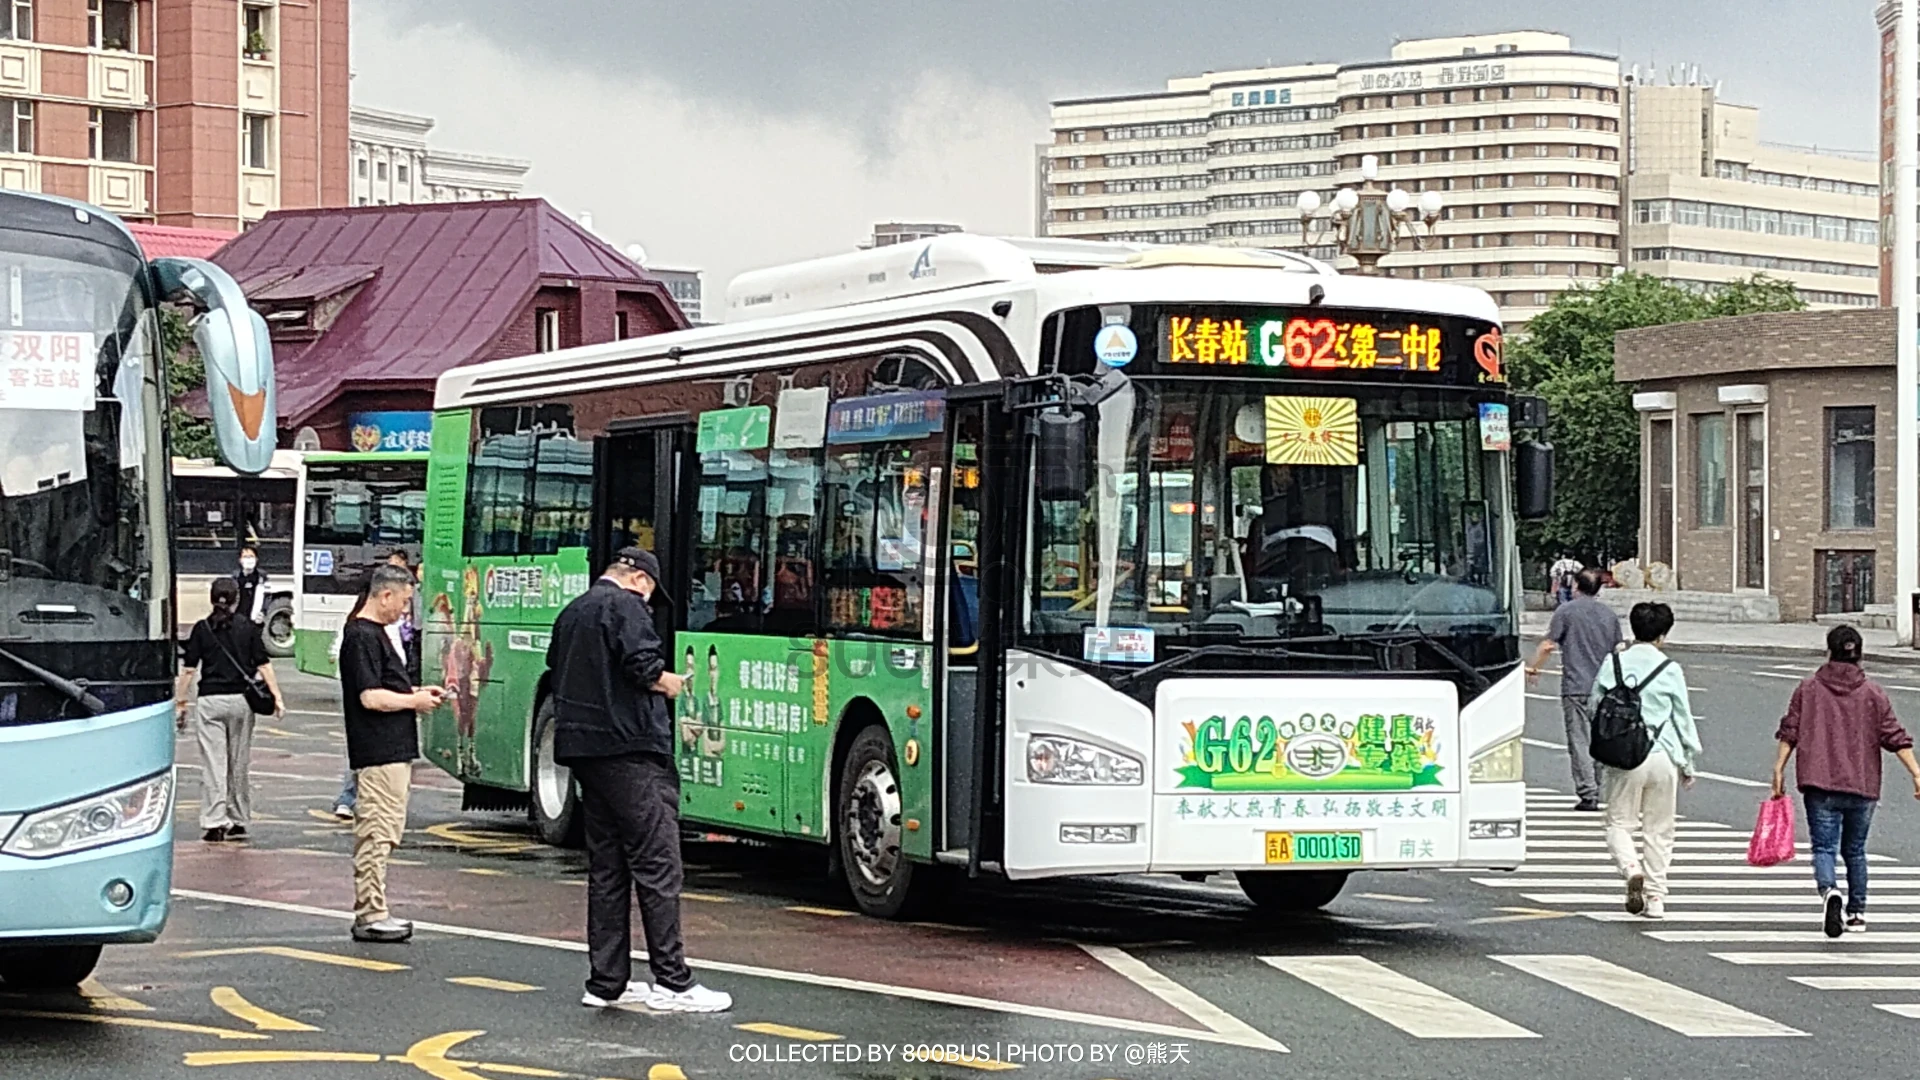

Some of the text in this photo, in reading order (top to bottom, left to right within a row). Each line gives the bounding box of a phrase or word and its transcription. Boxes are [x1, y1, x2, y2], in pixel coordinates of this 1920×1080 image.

[11, 334, 81, 363] 双阳
[1169, 317, 1248, 364] 长春站
[1260, 319, 1336, 368] G62
[8, 368, 80, 388] 客运站
[1357, 714, 1421, 742] 健康
[1194, 715, 1278, 774] G62
[1357, 743, 1424, 773] 专线
[1175, 797, 1448, 820] 奉献火热青春 弘扬敬老文明
[1297, 836, 1361, 860] 00013D
[1399, 838, 1436, 859] 南关
